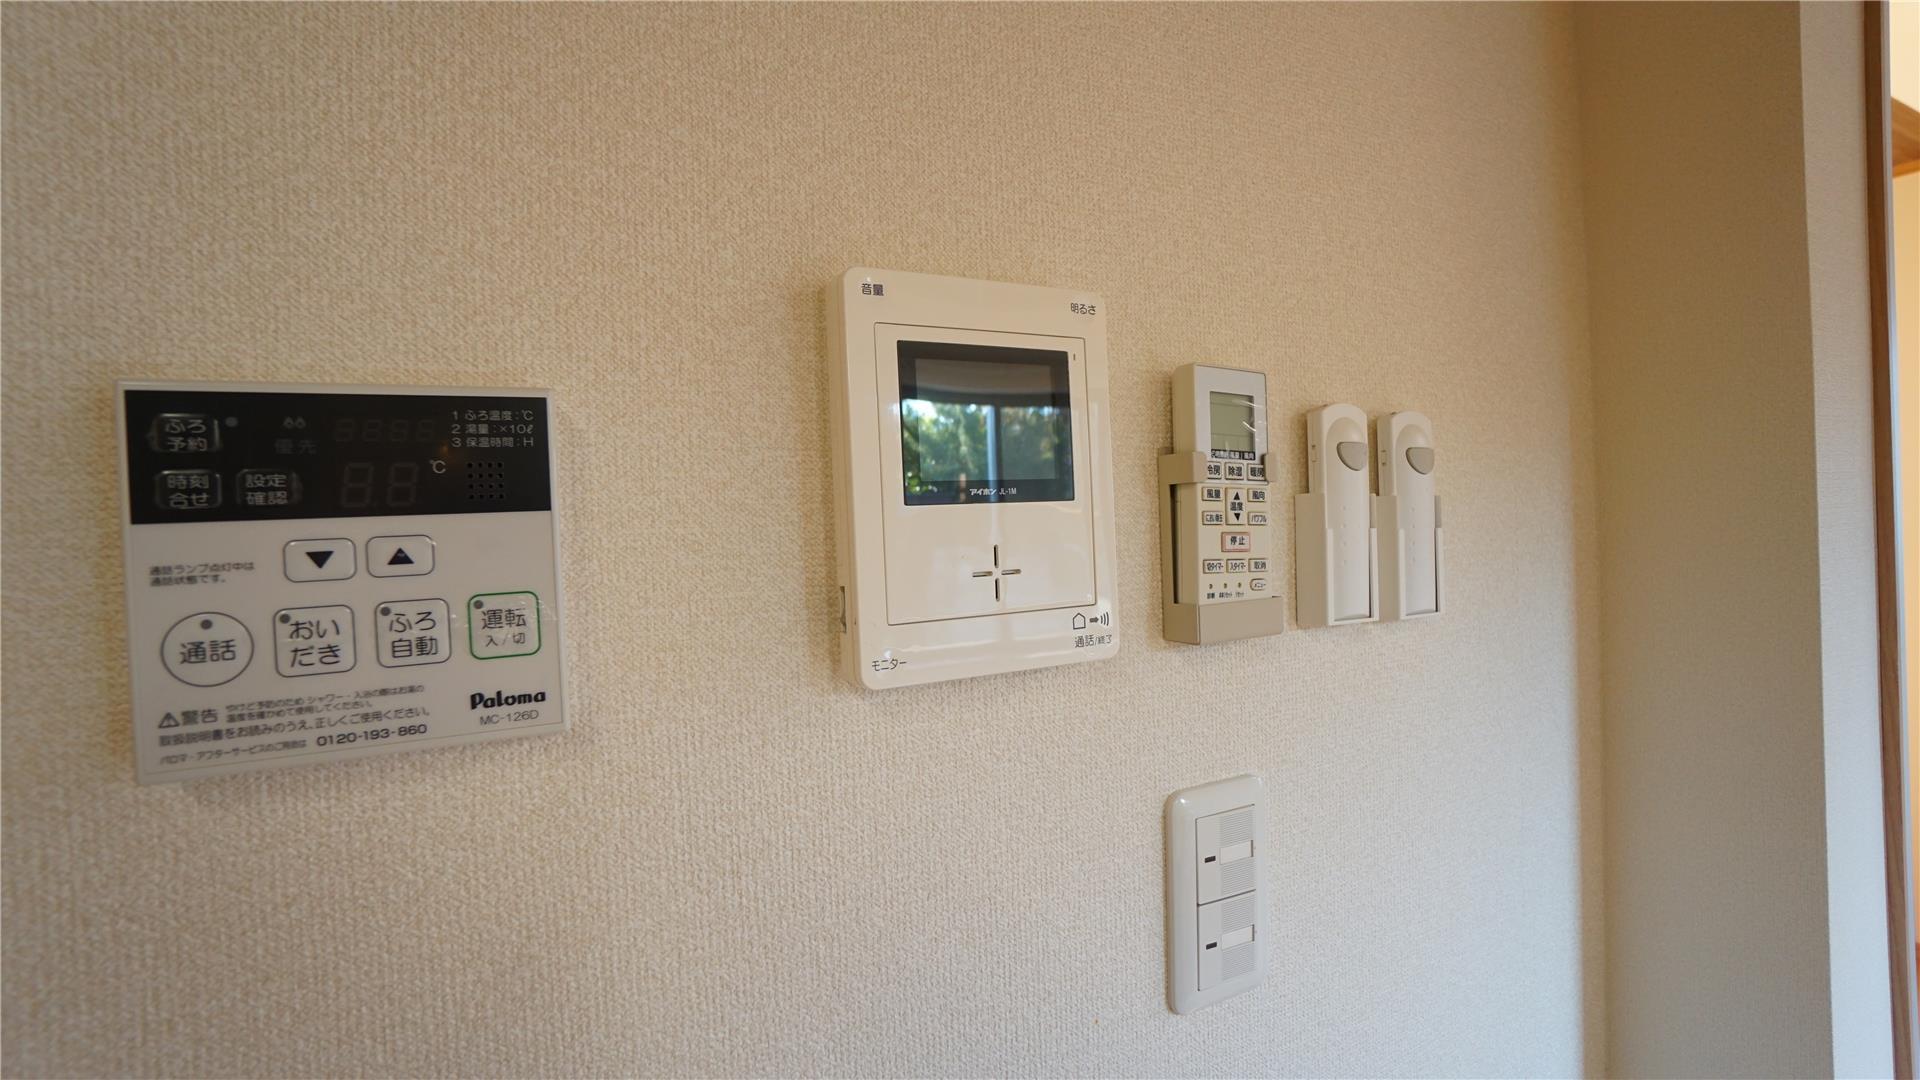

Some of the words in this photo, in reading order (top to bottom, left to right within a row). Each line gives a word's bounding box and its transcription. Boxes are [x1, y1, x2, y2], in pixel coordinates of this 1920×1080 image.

[861, 283, 884, 296] 音量
[1071, 302, 1096, 315] 明るさ
[452, 411, 459, 420] 1
[165, 419, 207, 433] ふろ
[452, 424, 461, 433] 2
[167, 437, 208, 451] 予約
[452, 437, 461, 447] 3
[167, 475, 209, 489] 時刻
[246, 474, 288, 488] 設定
[246, 491, 288, 505] 確認
[969, 488, 997, 496] アイホン
[999, 487, 1017, 495] JL-1M
[170, 492, 209, 508] 合せ
[1230, 536, 1245, 546] 停止
[389, 611, 437, 632] ふろ
[481, 608, 526, 629] 運転
[289, 619, 340, 639] おい
[180, 639, 236, 664] 通話
[392, 636, 439, 658] 自動
[290, 644, 341, 668] だき
[872, 658, 907, 671] モニター
[470, 690, 546, 710] Paloma
[181, 709, 218, 726] 警告
[479, 709, 539, 726] MC-126D
[316, 723, 427, 747] 0120-193-860
